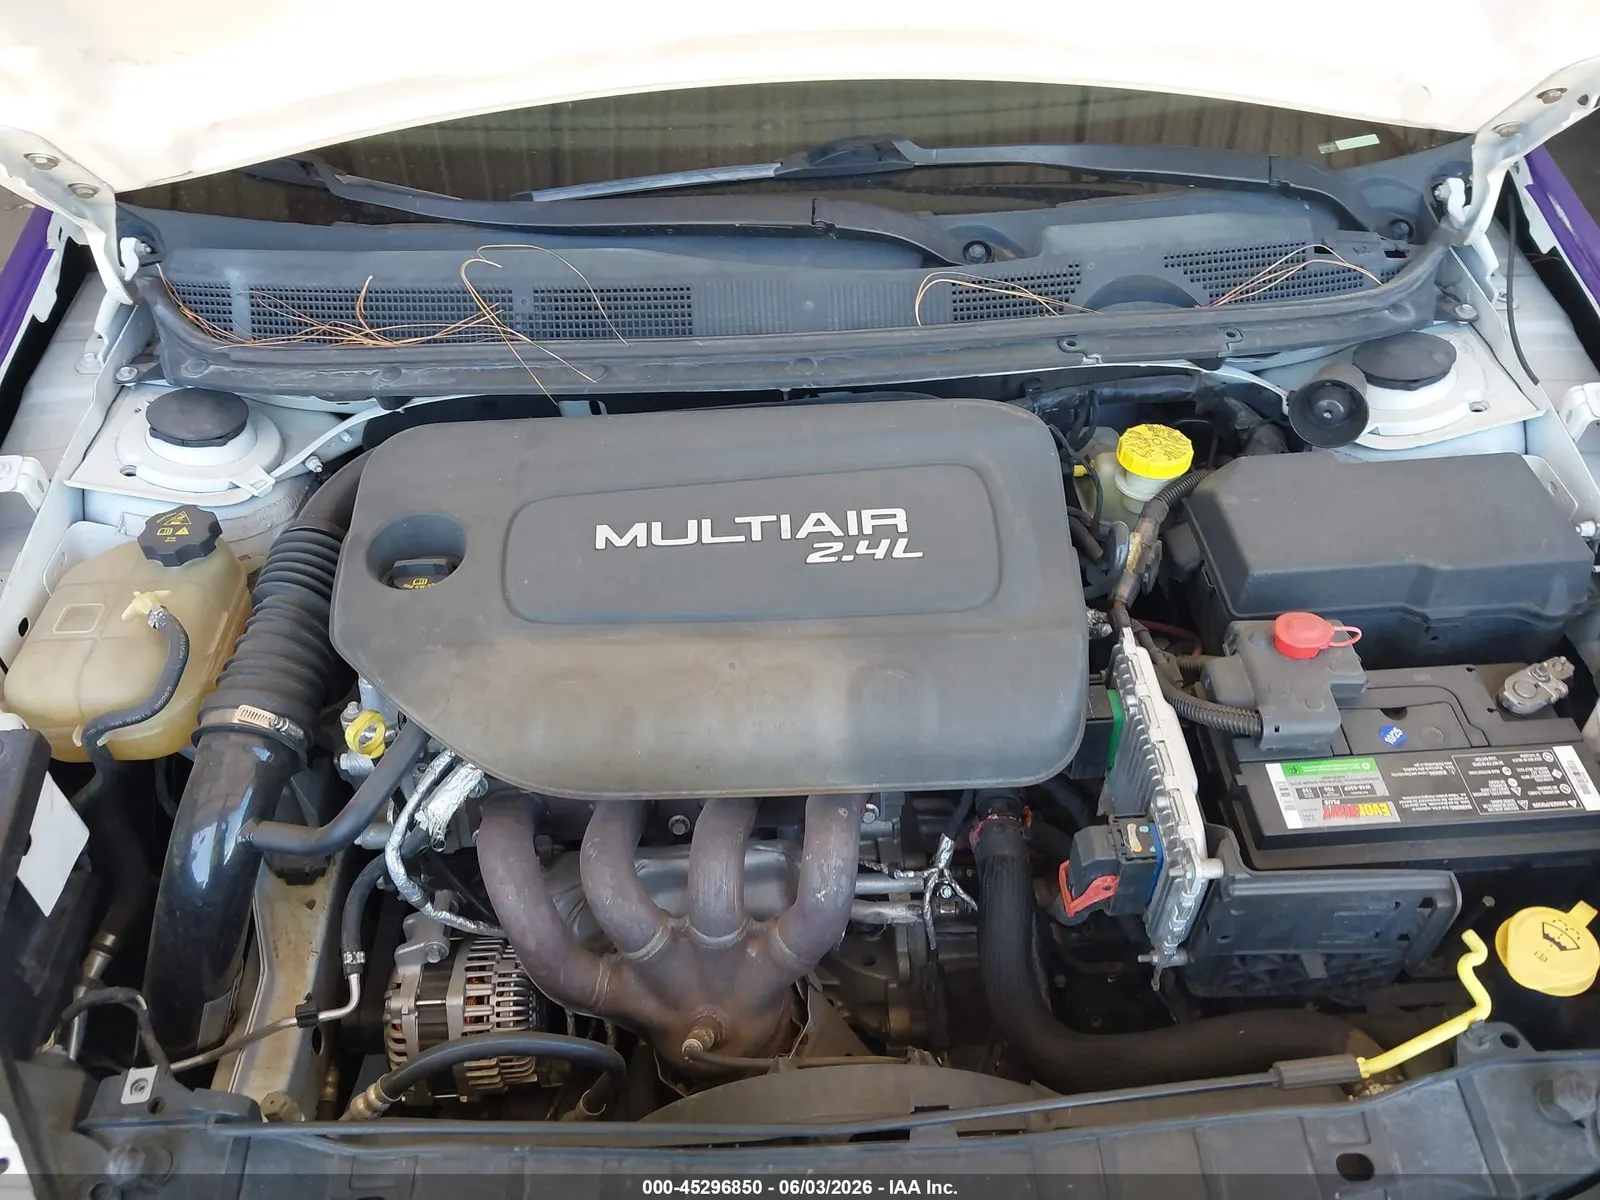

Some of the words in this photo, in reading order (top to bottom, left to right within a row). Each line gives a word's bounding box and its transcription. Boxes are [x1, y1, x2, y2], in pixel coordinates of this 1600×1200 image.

[594, 508, 909, 550] MULTIAIR
[805, 537, 924, 564] 2.4L
[1384, 726, 1403, 745] 10/25
